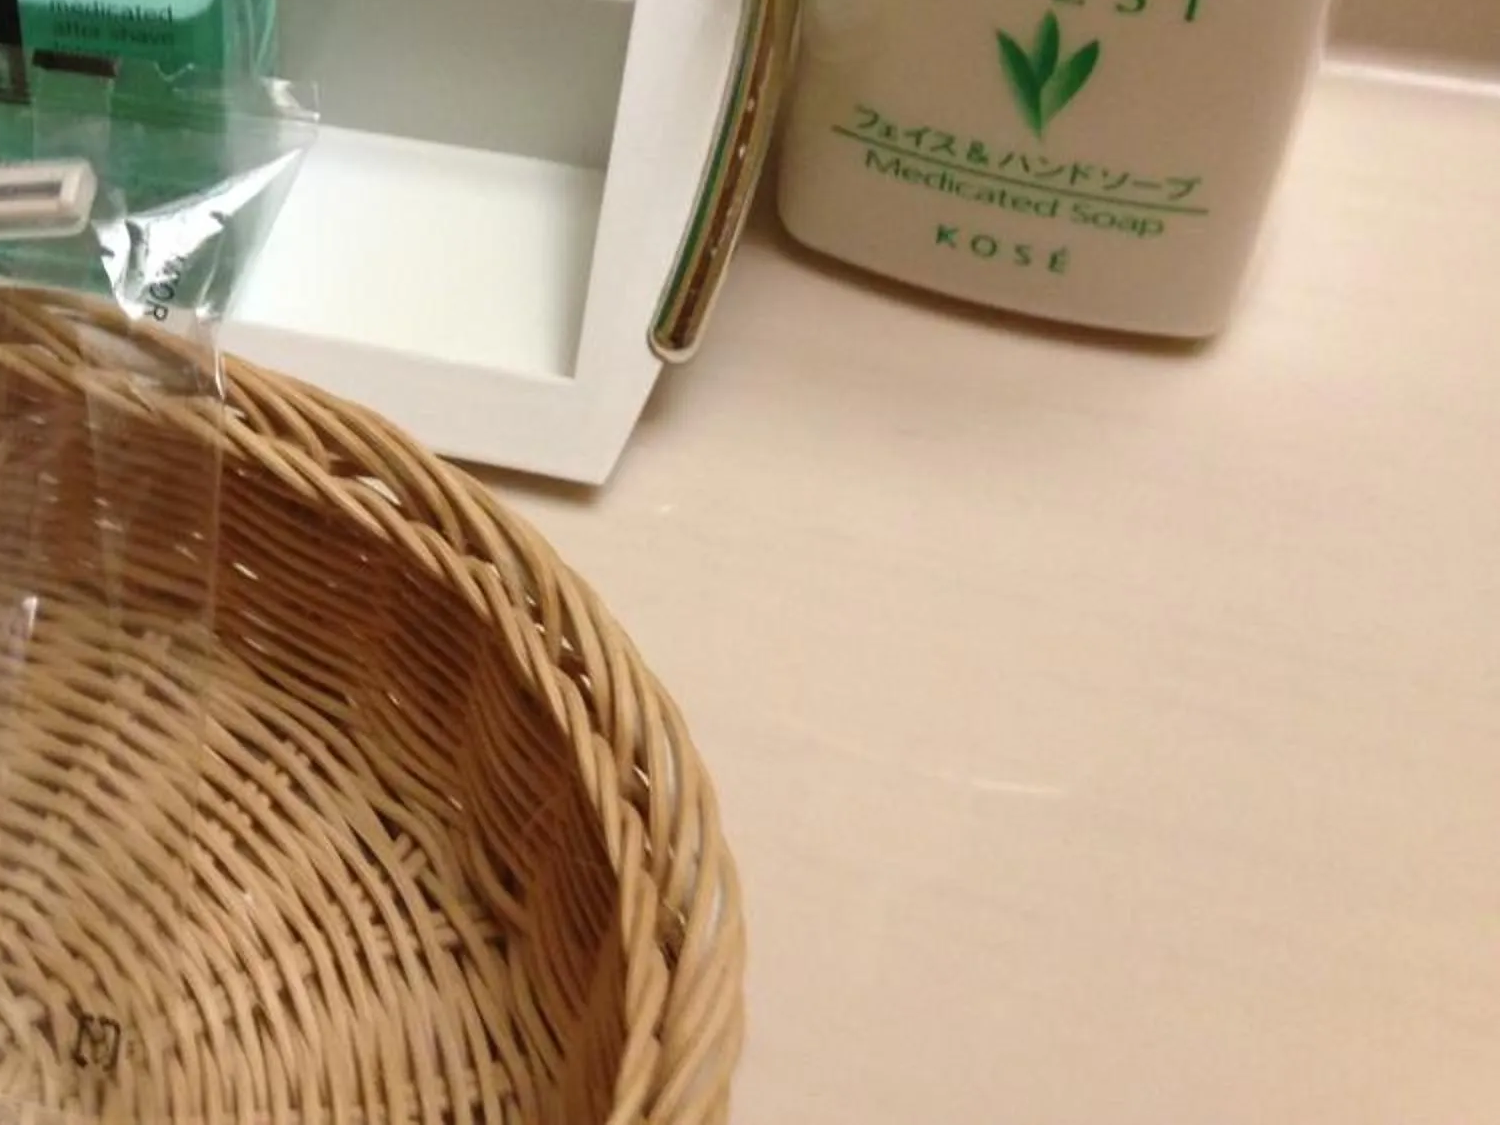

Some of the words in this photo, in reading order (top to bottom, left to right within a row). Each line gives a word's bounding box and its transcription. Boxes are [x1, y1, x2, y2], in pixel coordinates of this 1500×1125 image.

[864, 149, 1060, 220] Medicated
[1071, 202, 1166, 238] Soap
[936, 223, 1071, 275] KOSÉ
